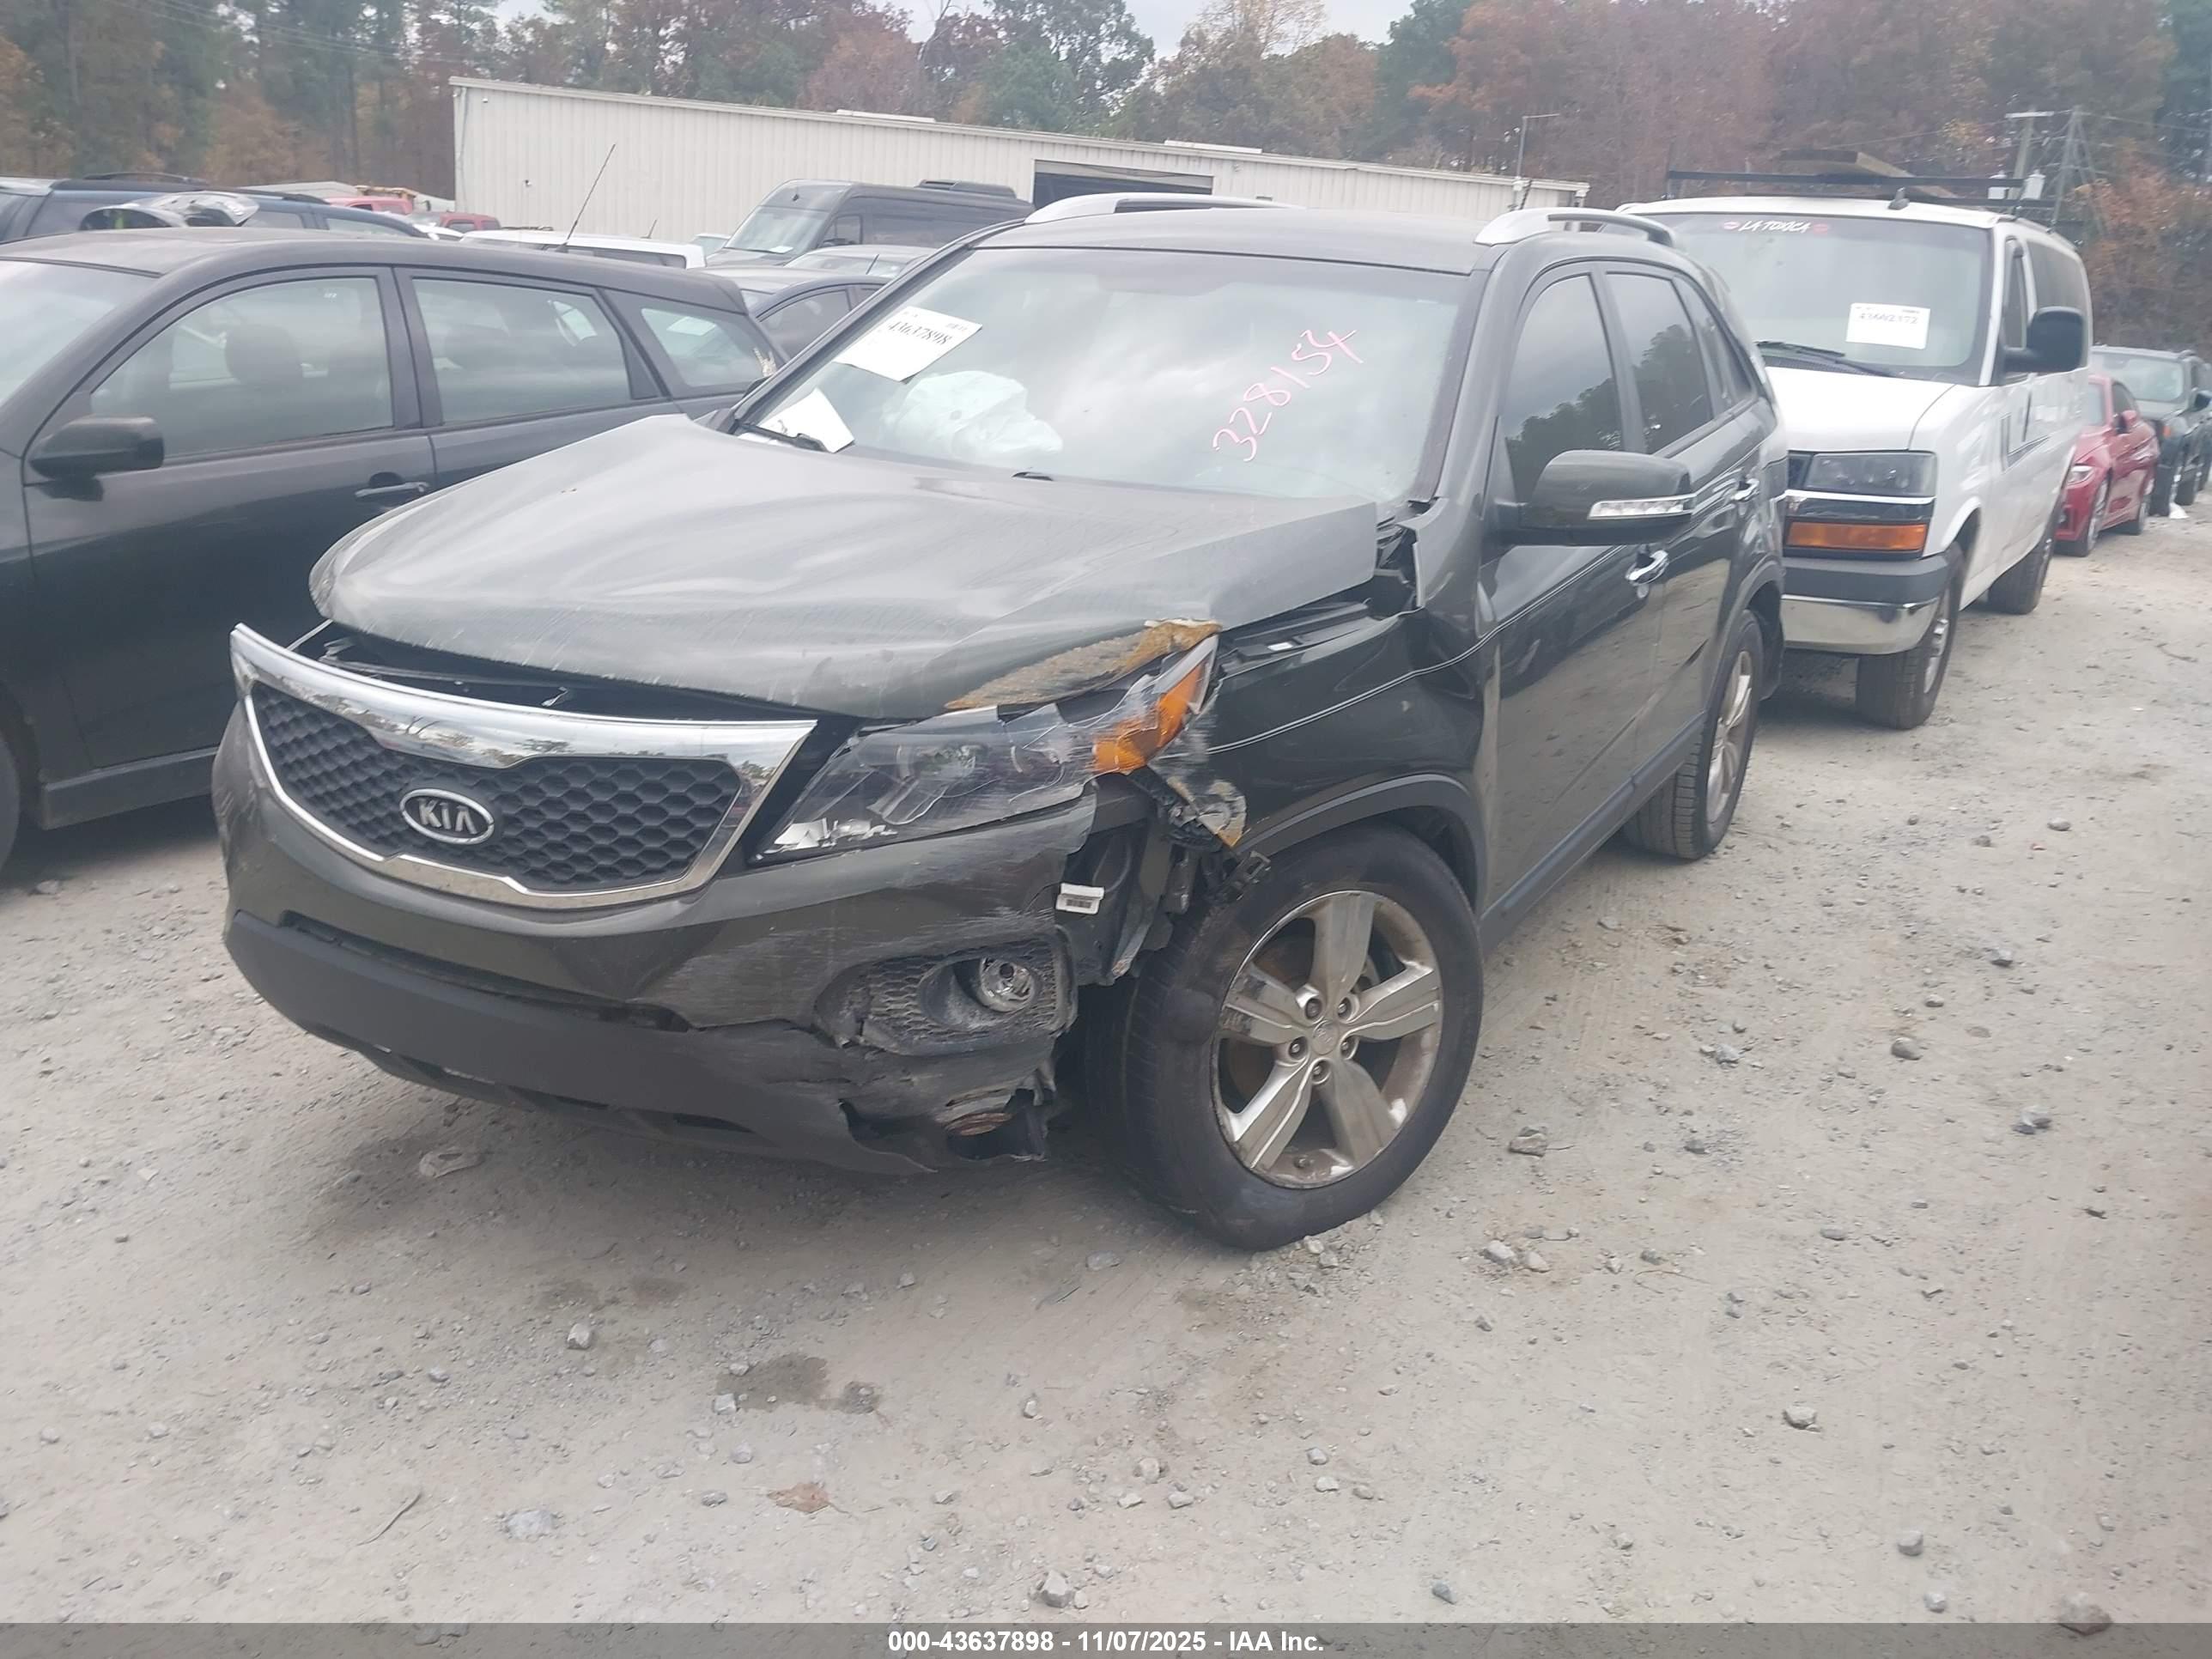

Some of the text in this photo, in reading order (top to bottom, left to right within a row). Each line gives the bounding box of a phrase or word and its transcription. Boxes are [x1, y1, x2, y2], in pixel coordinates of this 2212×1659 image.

[1738, 220, 1764, 232] LA
[888, 321, 953, 345] 43637898
[1212, 329, 1364, 462] 328154
[416, 797, 478, 835] KIA
